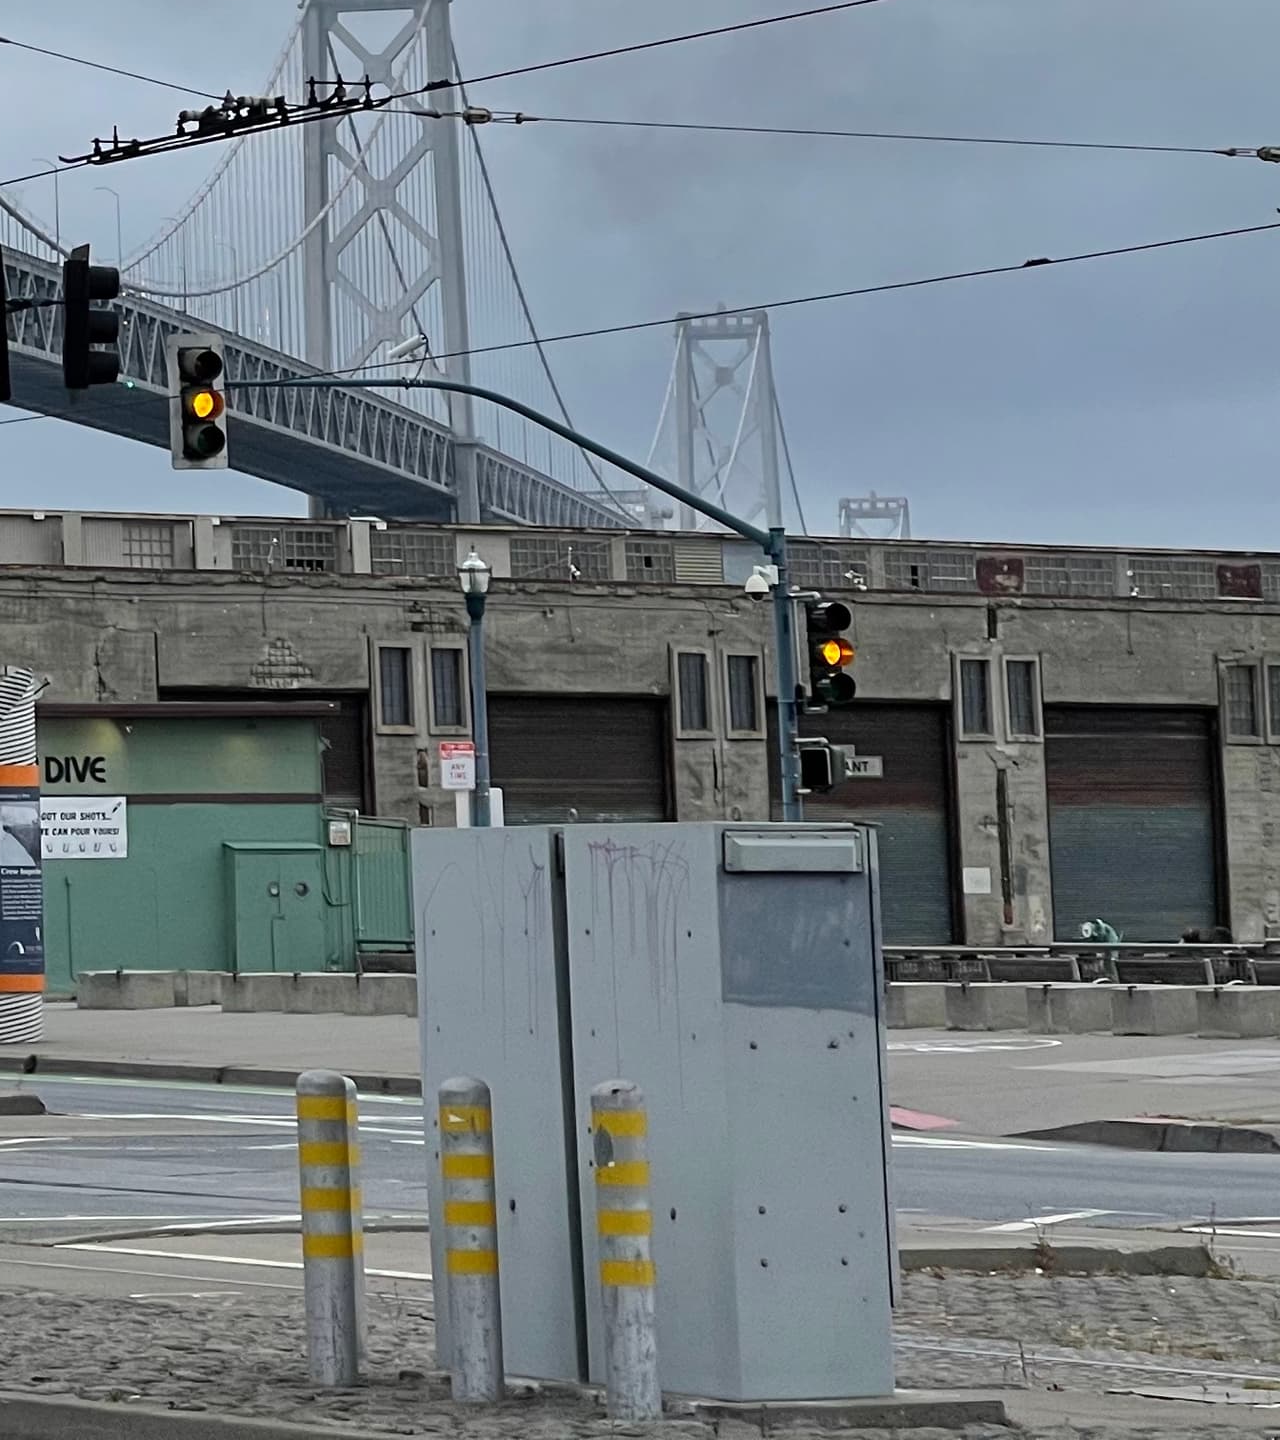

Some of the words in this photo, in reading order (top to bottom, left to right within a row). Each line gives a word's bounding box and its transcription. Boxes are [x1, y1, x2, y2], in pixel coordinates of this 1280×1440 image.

[45, 755, 107, 783] DIVE
[60, 811, 77, 821] OUR
[52, 827, 68, 836] CAN
[70, 827, 91, 836] POUR
